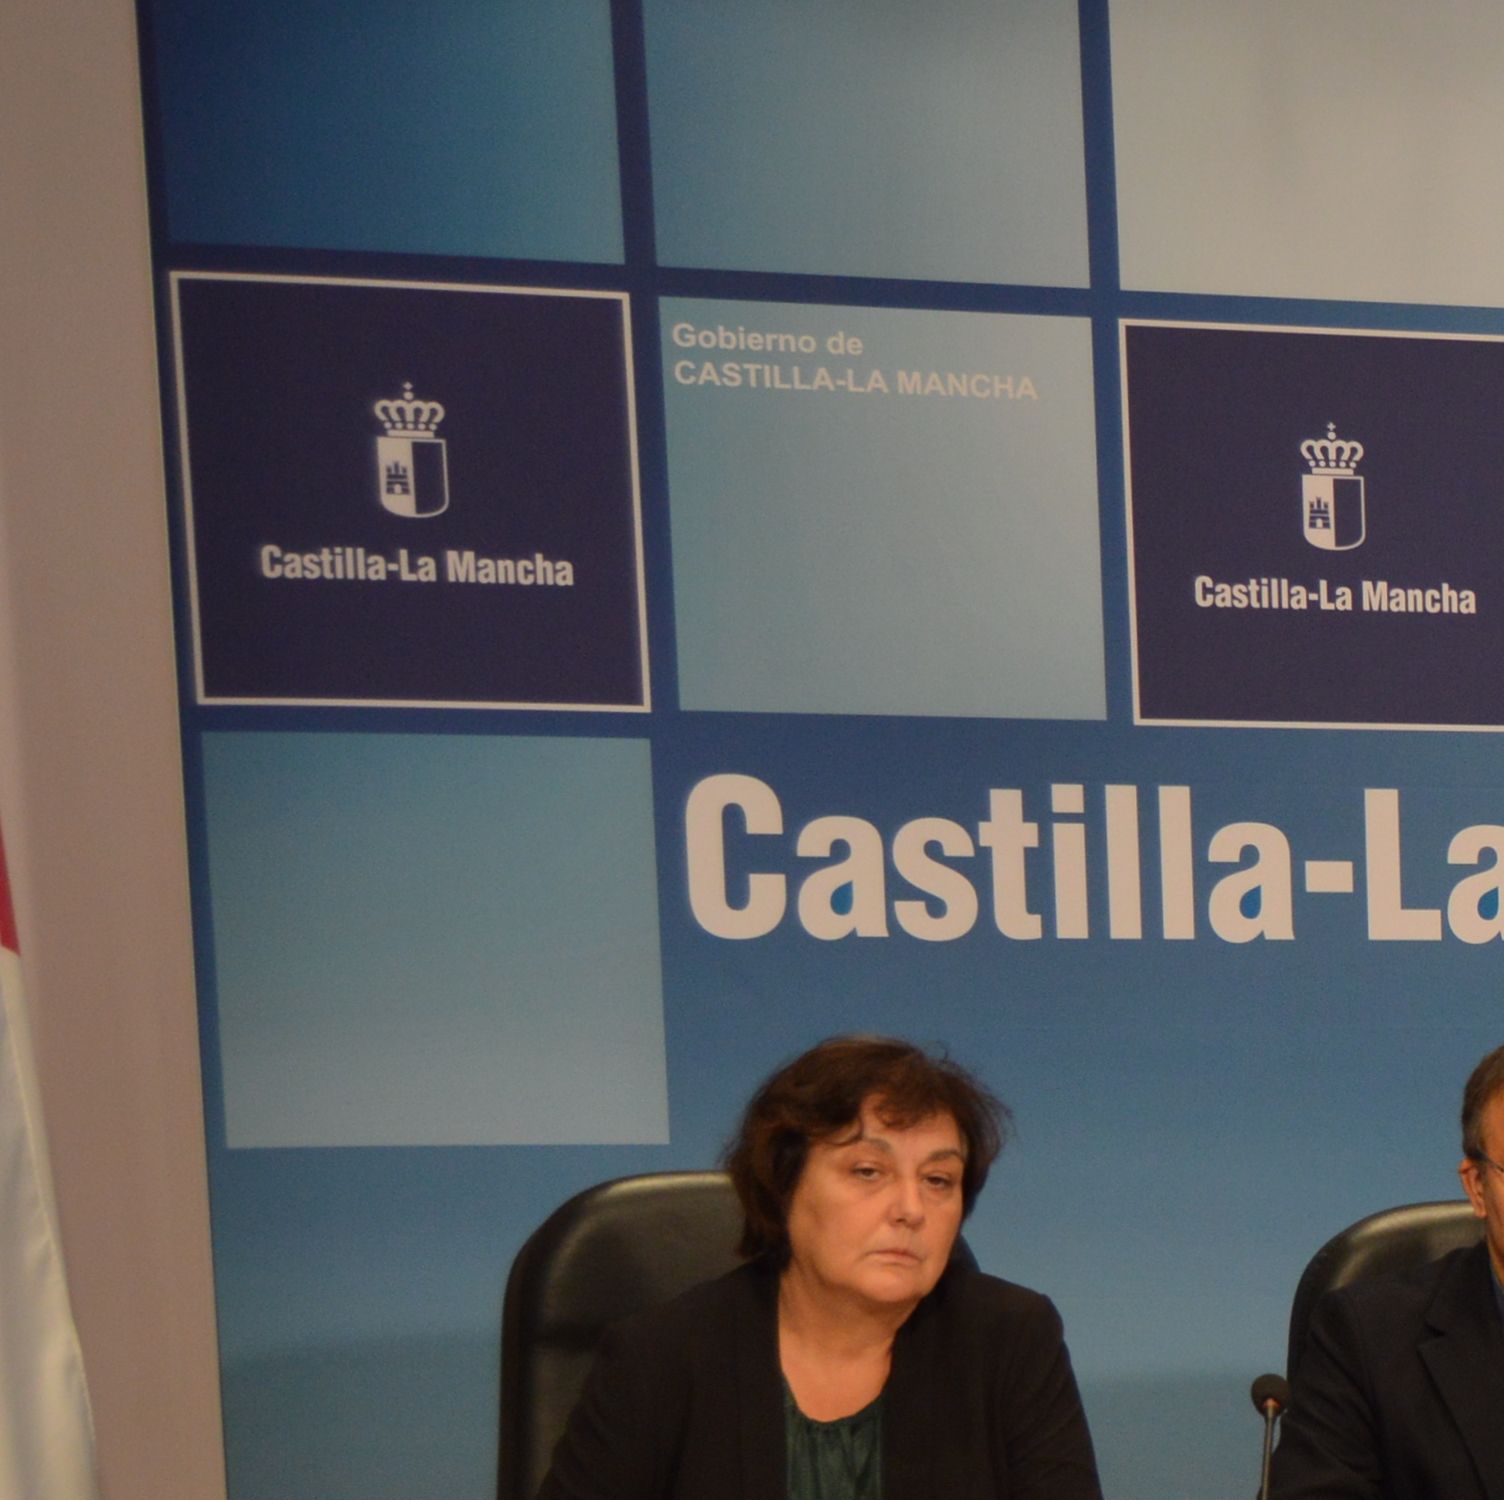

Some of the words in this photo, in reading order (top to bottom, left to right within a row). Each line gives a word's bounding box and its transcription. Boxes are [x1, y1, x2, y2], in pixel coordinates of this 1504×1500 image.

[672, 322, 817, 355] Gobierno
[827, 329, 863, 356] de
[674, 360, 889, 394] CASTILLA-LA
[897, 369, 1038, 400] MANCHA
[260, 545, 438, 583] Castilla-La
[446, 550, 574, 587] Mancha
[1194, 575, 1353, 612] Castilla-La
[1362, 580, 1477, 615] Mancha
